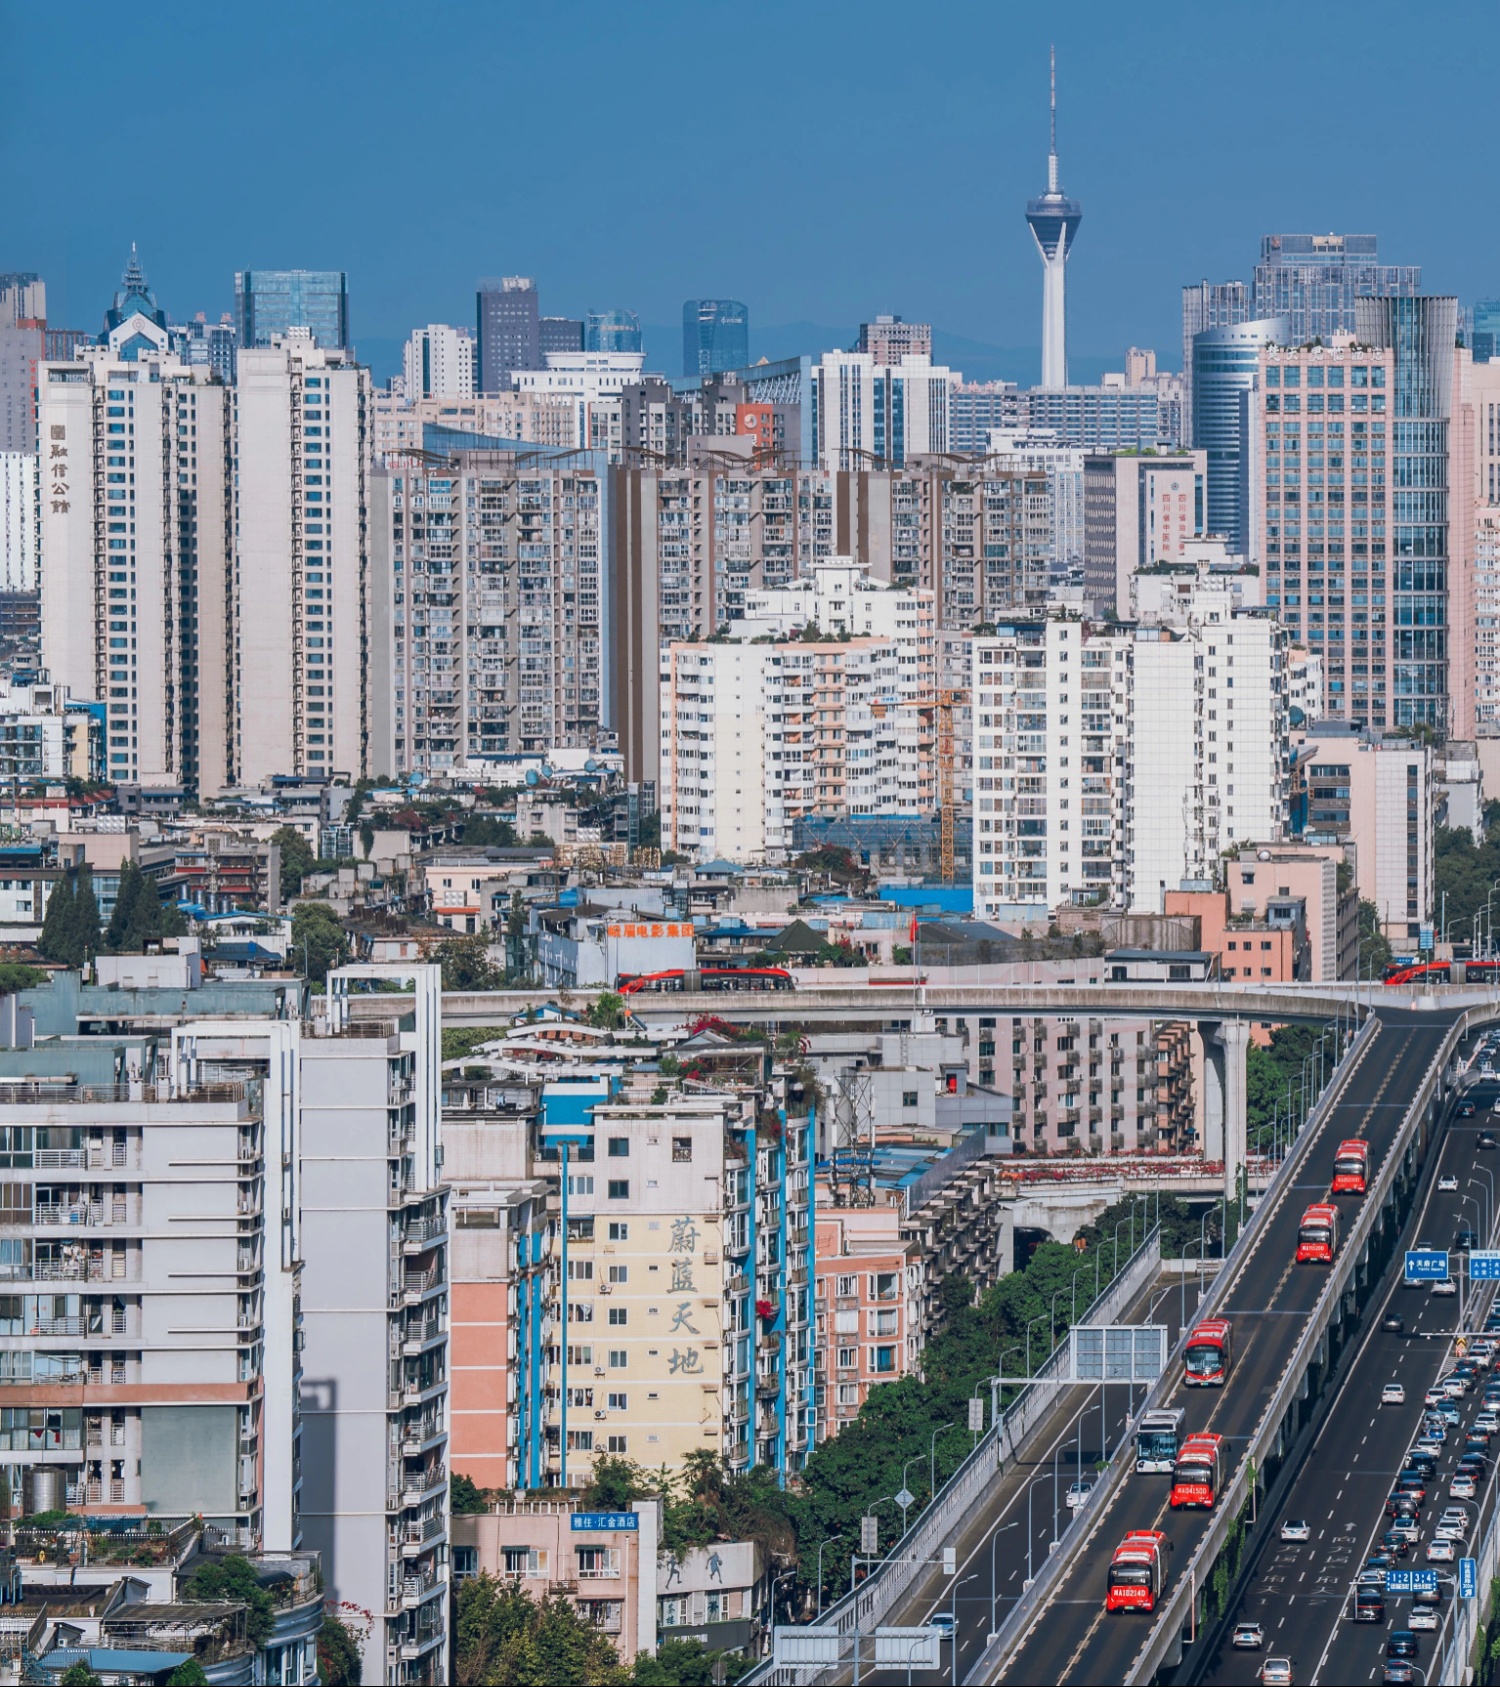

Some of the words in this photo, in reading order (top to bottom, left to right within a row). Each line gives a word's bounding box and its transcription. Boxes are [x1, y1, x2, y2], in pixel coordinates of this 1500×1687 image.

[1162, 494, 1171, 552] 四川省中医院
[666, 1216, 704, 1375] 蔚蓝天地
[1403, 1573, 1409, 1582] 2
[1415, 1573, 1420, 1582] 3
[1426, 1573, 1432, 1582] 4
